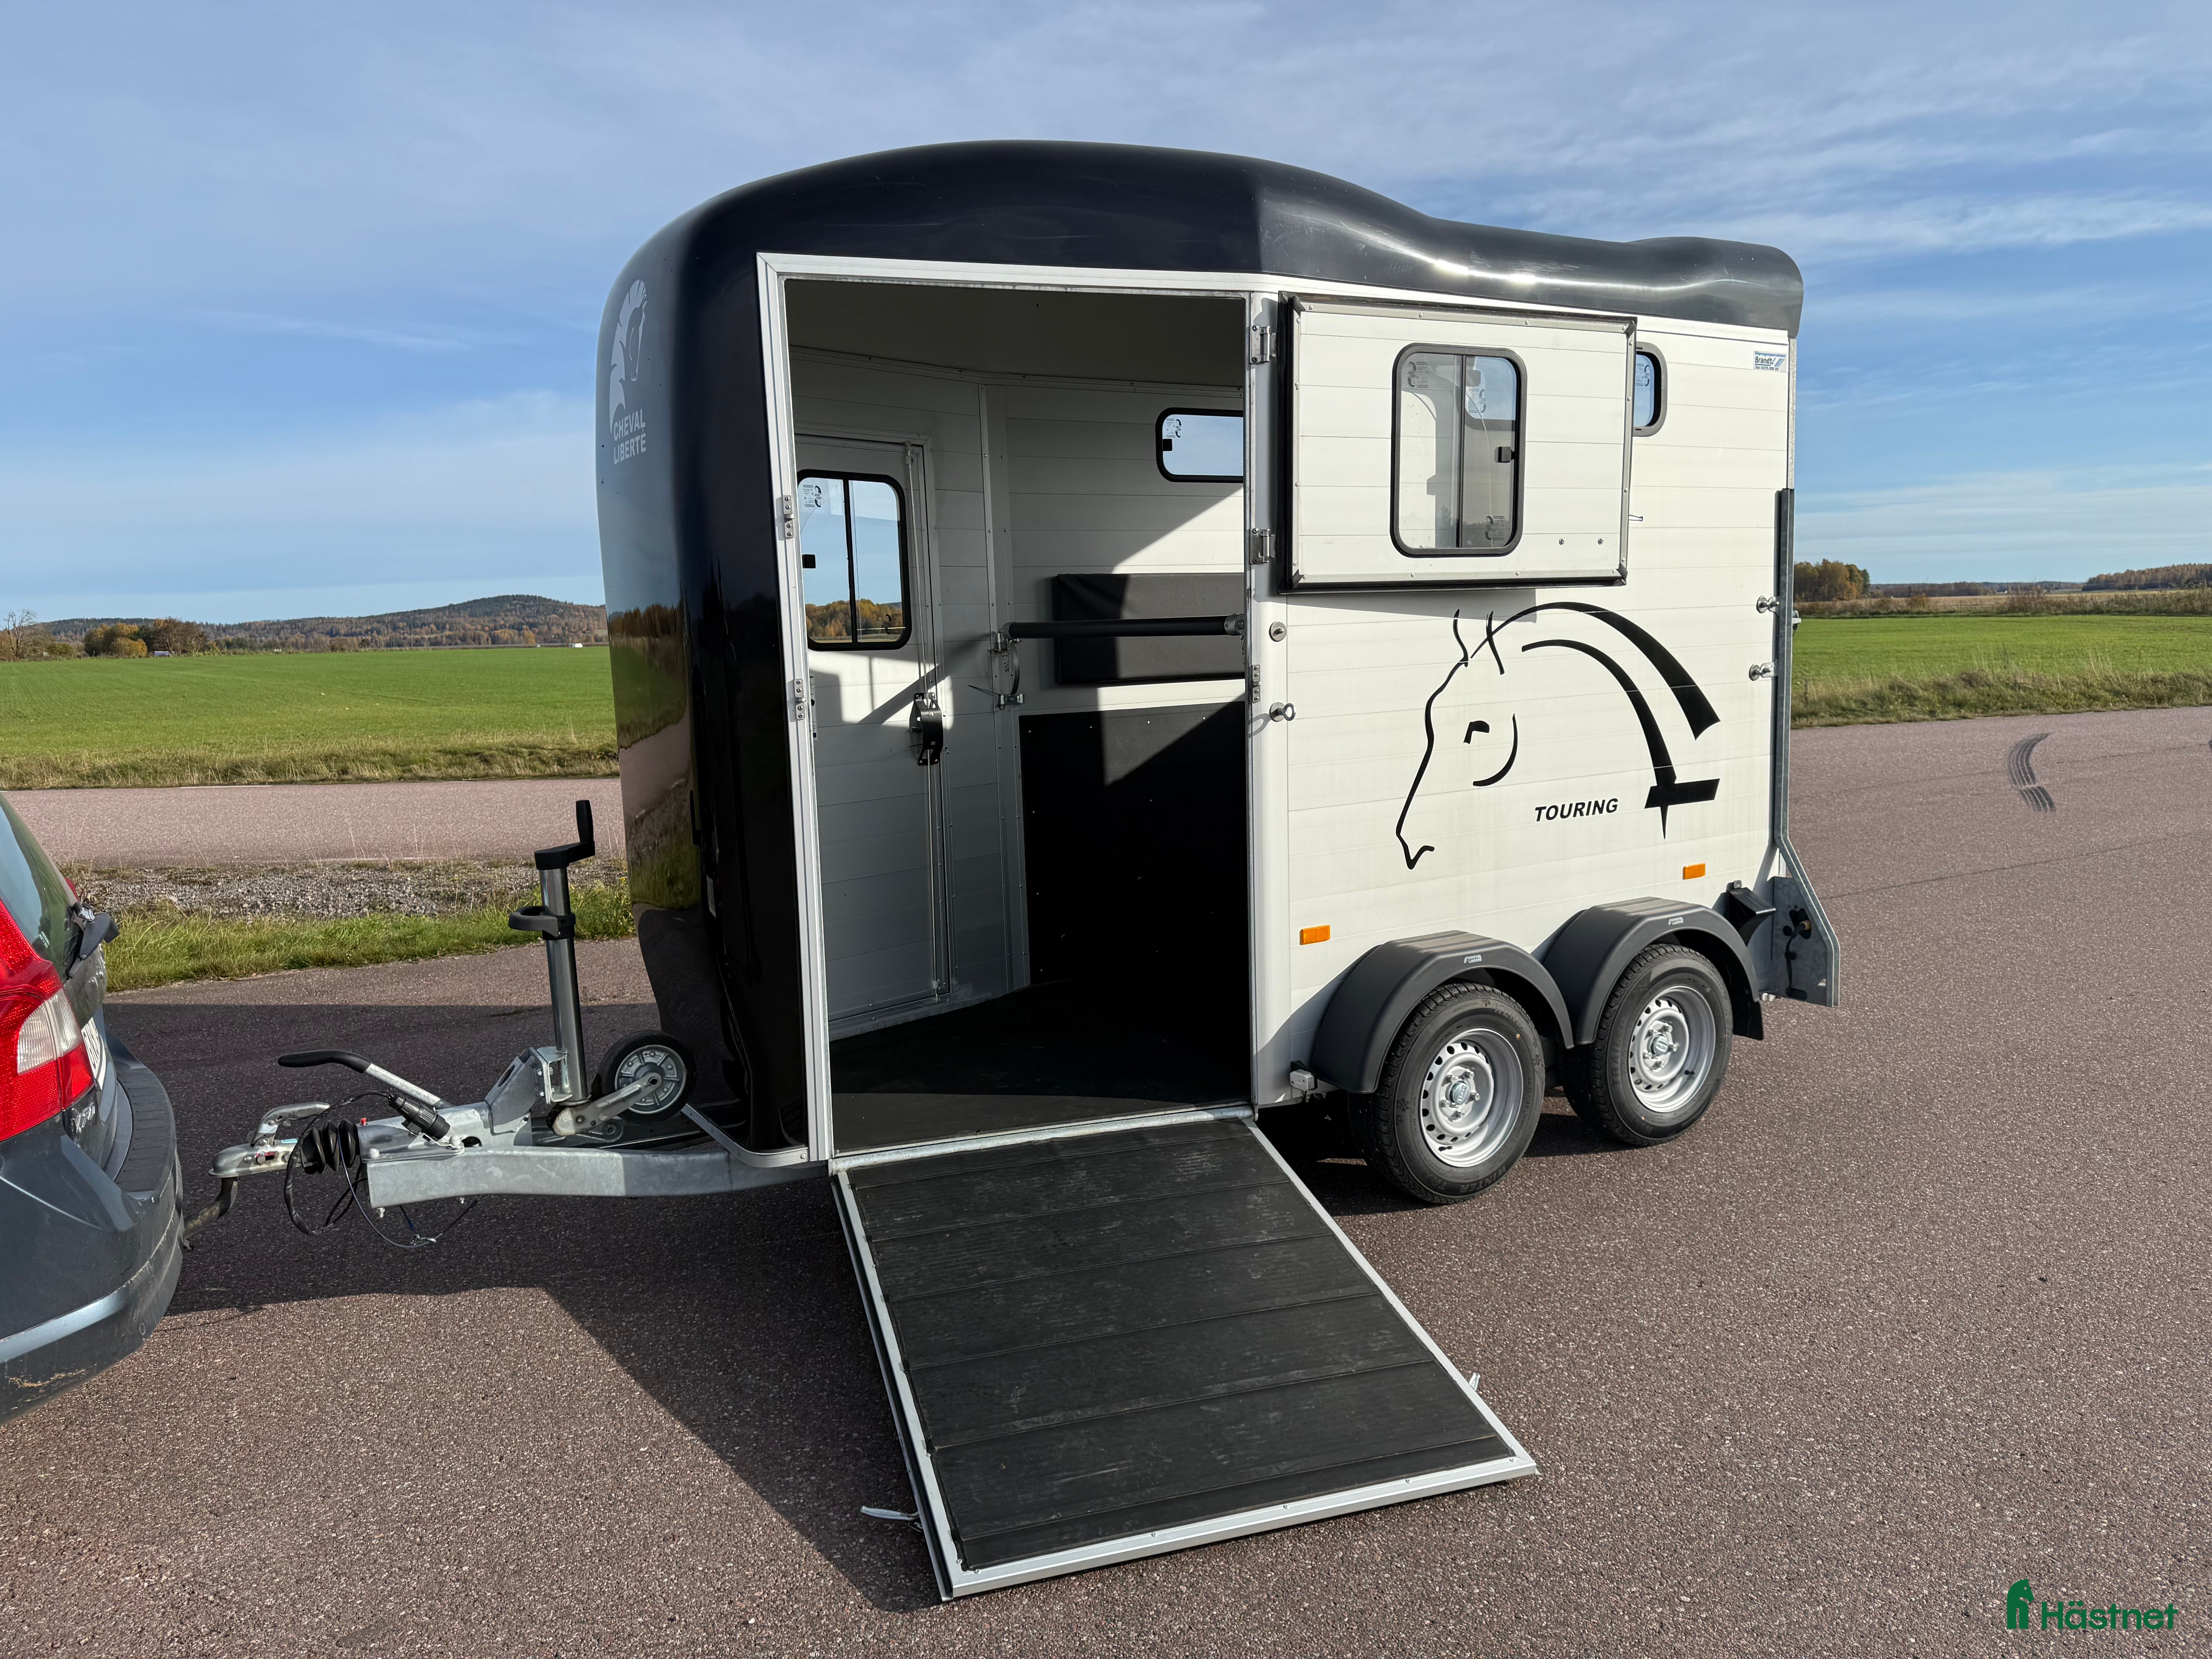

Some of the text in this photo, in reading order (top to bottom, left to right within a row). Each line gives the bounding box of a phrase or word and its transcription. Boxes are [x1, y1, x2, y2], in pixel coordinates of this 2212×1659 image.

[1755, 356, 1772, 365] Brandt
[614, 409, 646, 441] CHEVAL
[614, 429, 646, 464] LIBERTÉ
[1535, 798, 1618, 822] TOURING
[1459, 1165, 1506, 1193] WINTER
